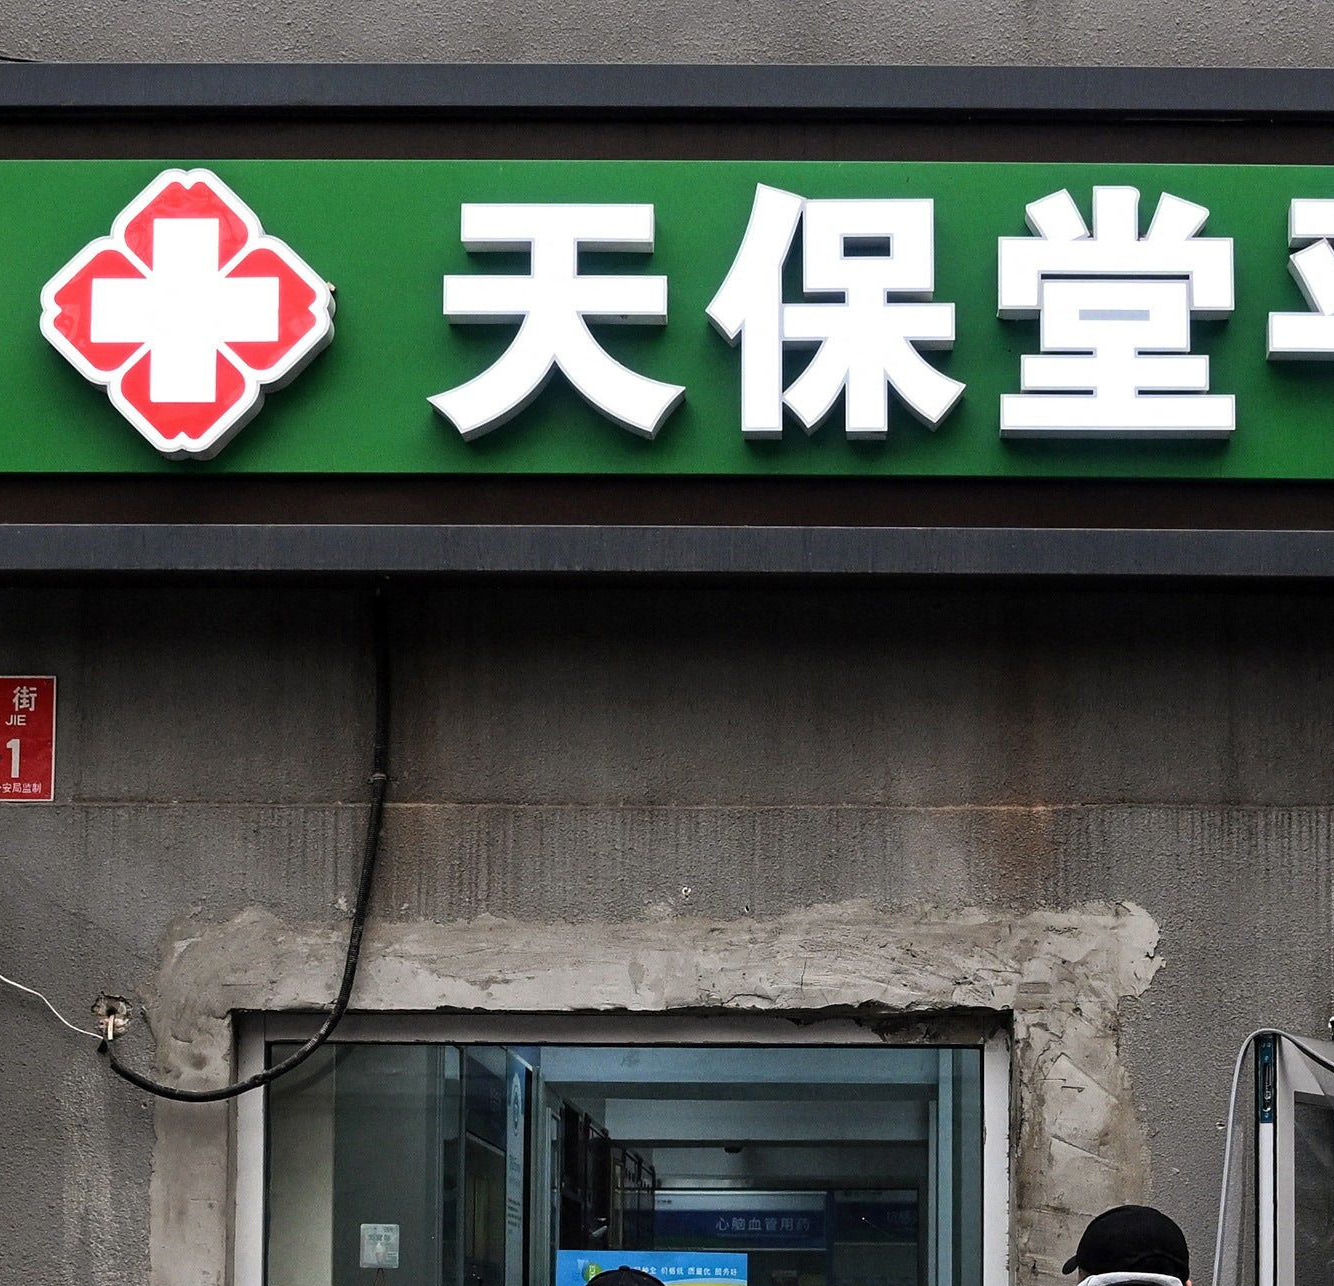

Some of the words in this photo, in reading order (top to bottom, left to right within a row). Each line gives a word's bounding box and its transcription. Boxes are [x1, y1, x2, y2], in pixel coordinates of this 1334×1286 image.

[5, 714, 27, 726] JIE
[715, 1216, 811, 1232] 心脑血管用药
